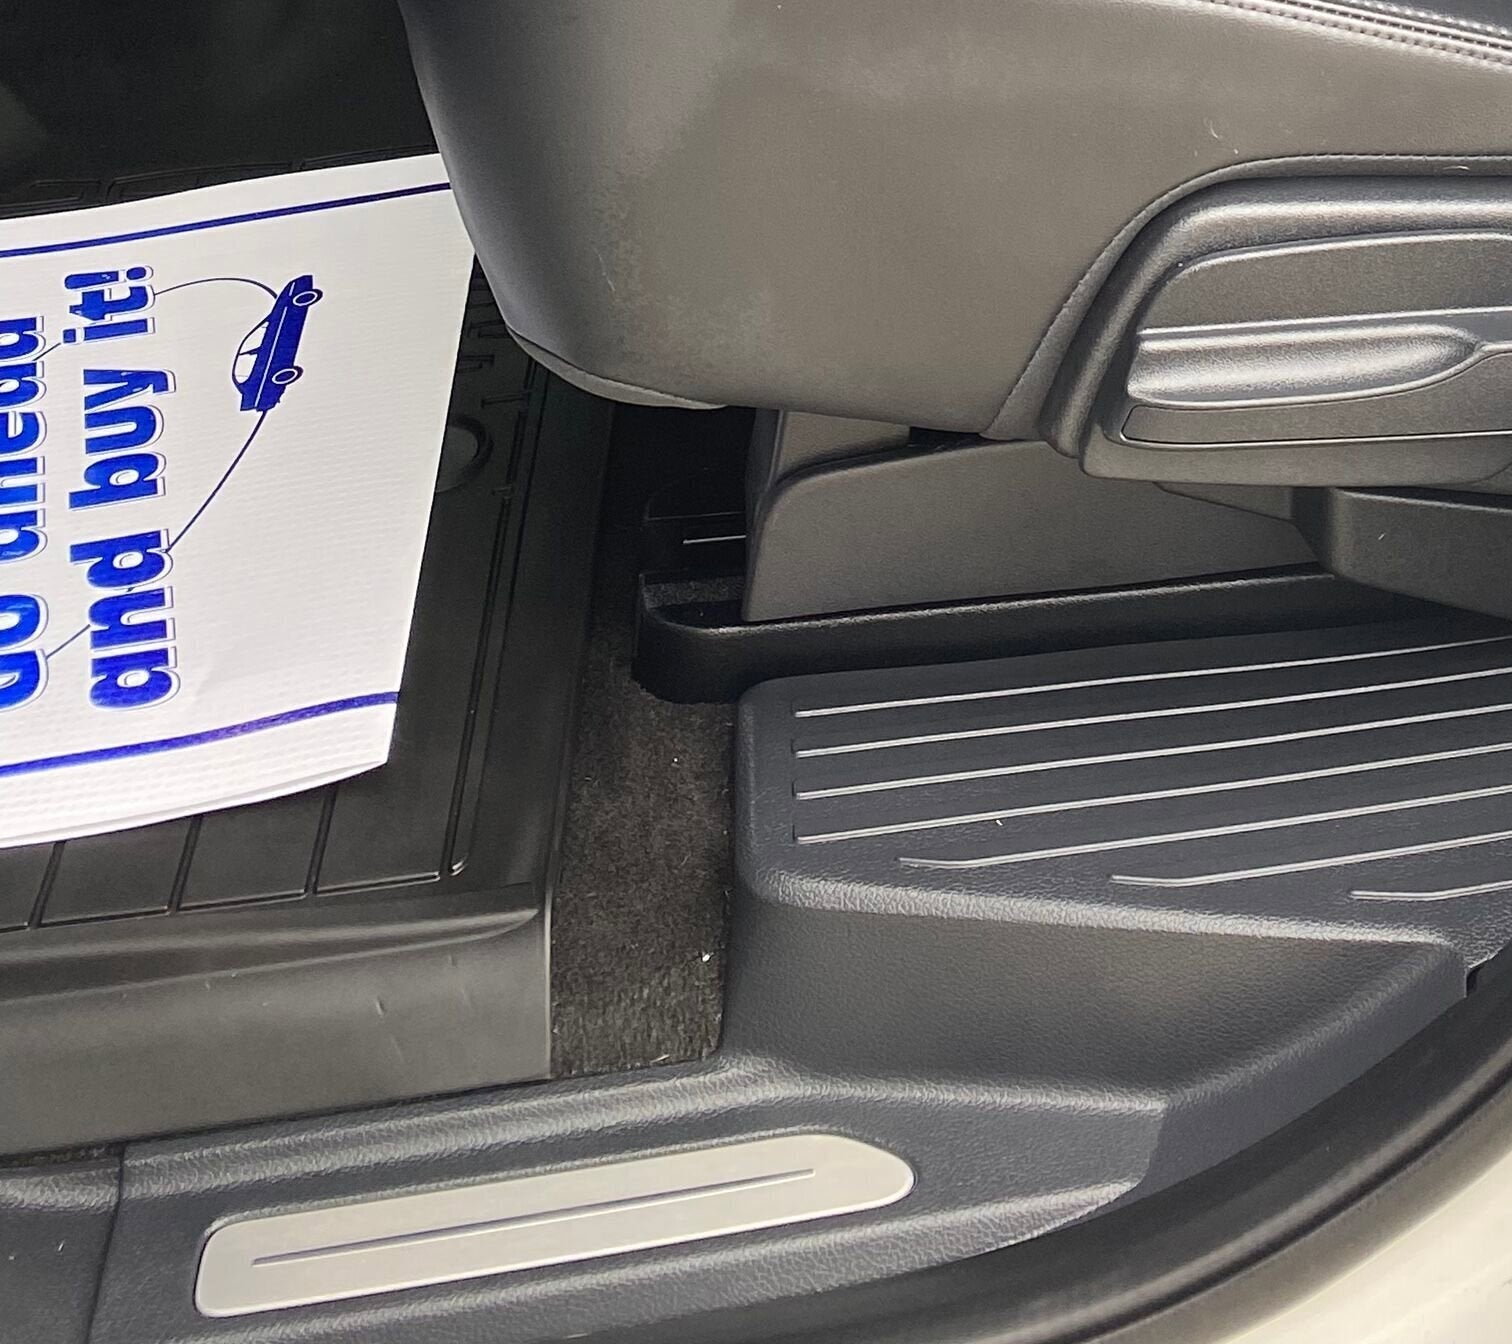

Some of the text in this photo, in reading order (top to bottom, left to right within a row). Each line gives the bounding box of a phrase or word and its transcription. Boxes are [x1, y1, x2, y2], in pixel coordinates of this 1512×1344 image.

[61, 264, 180, 710] and buy it!
